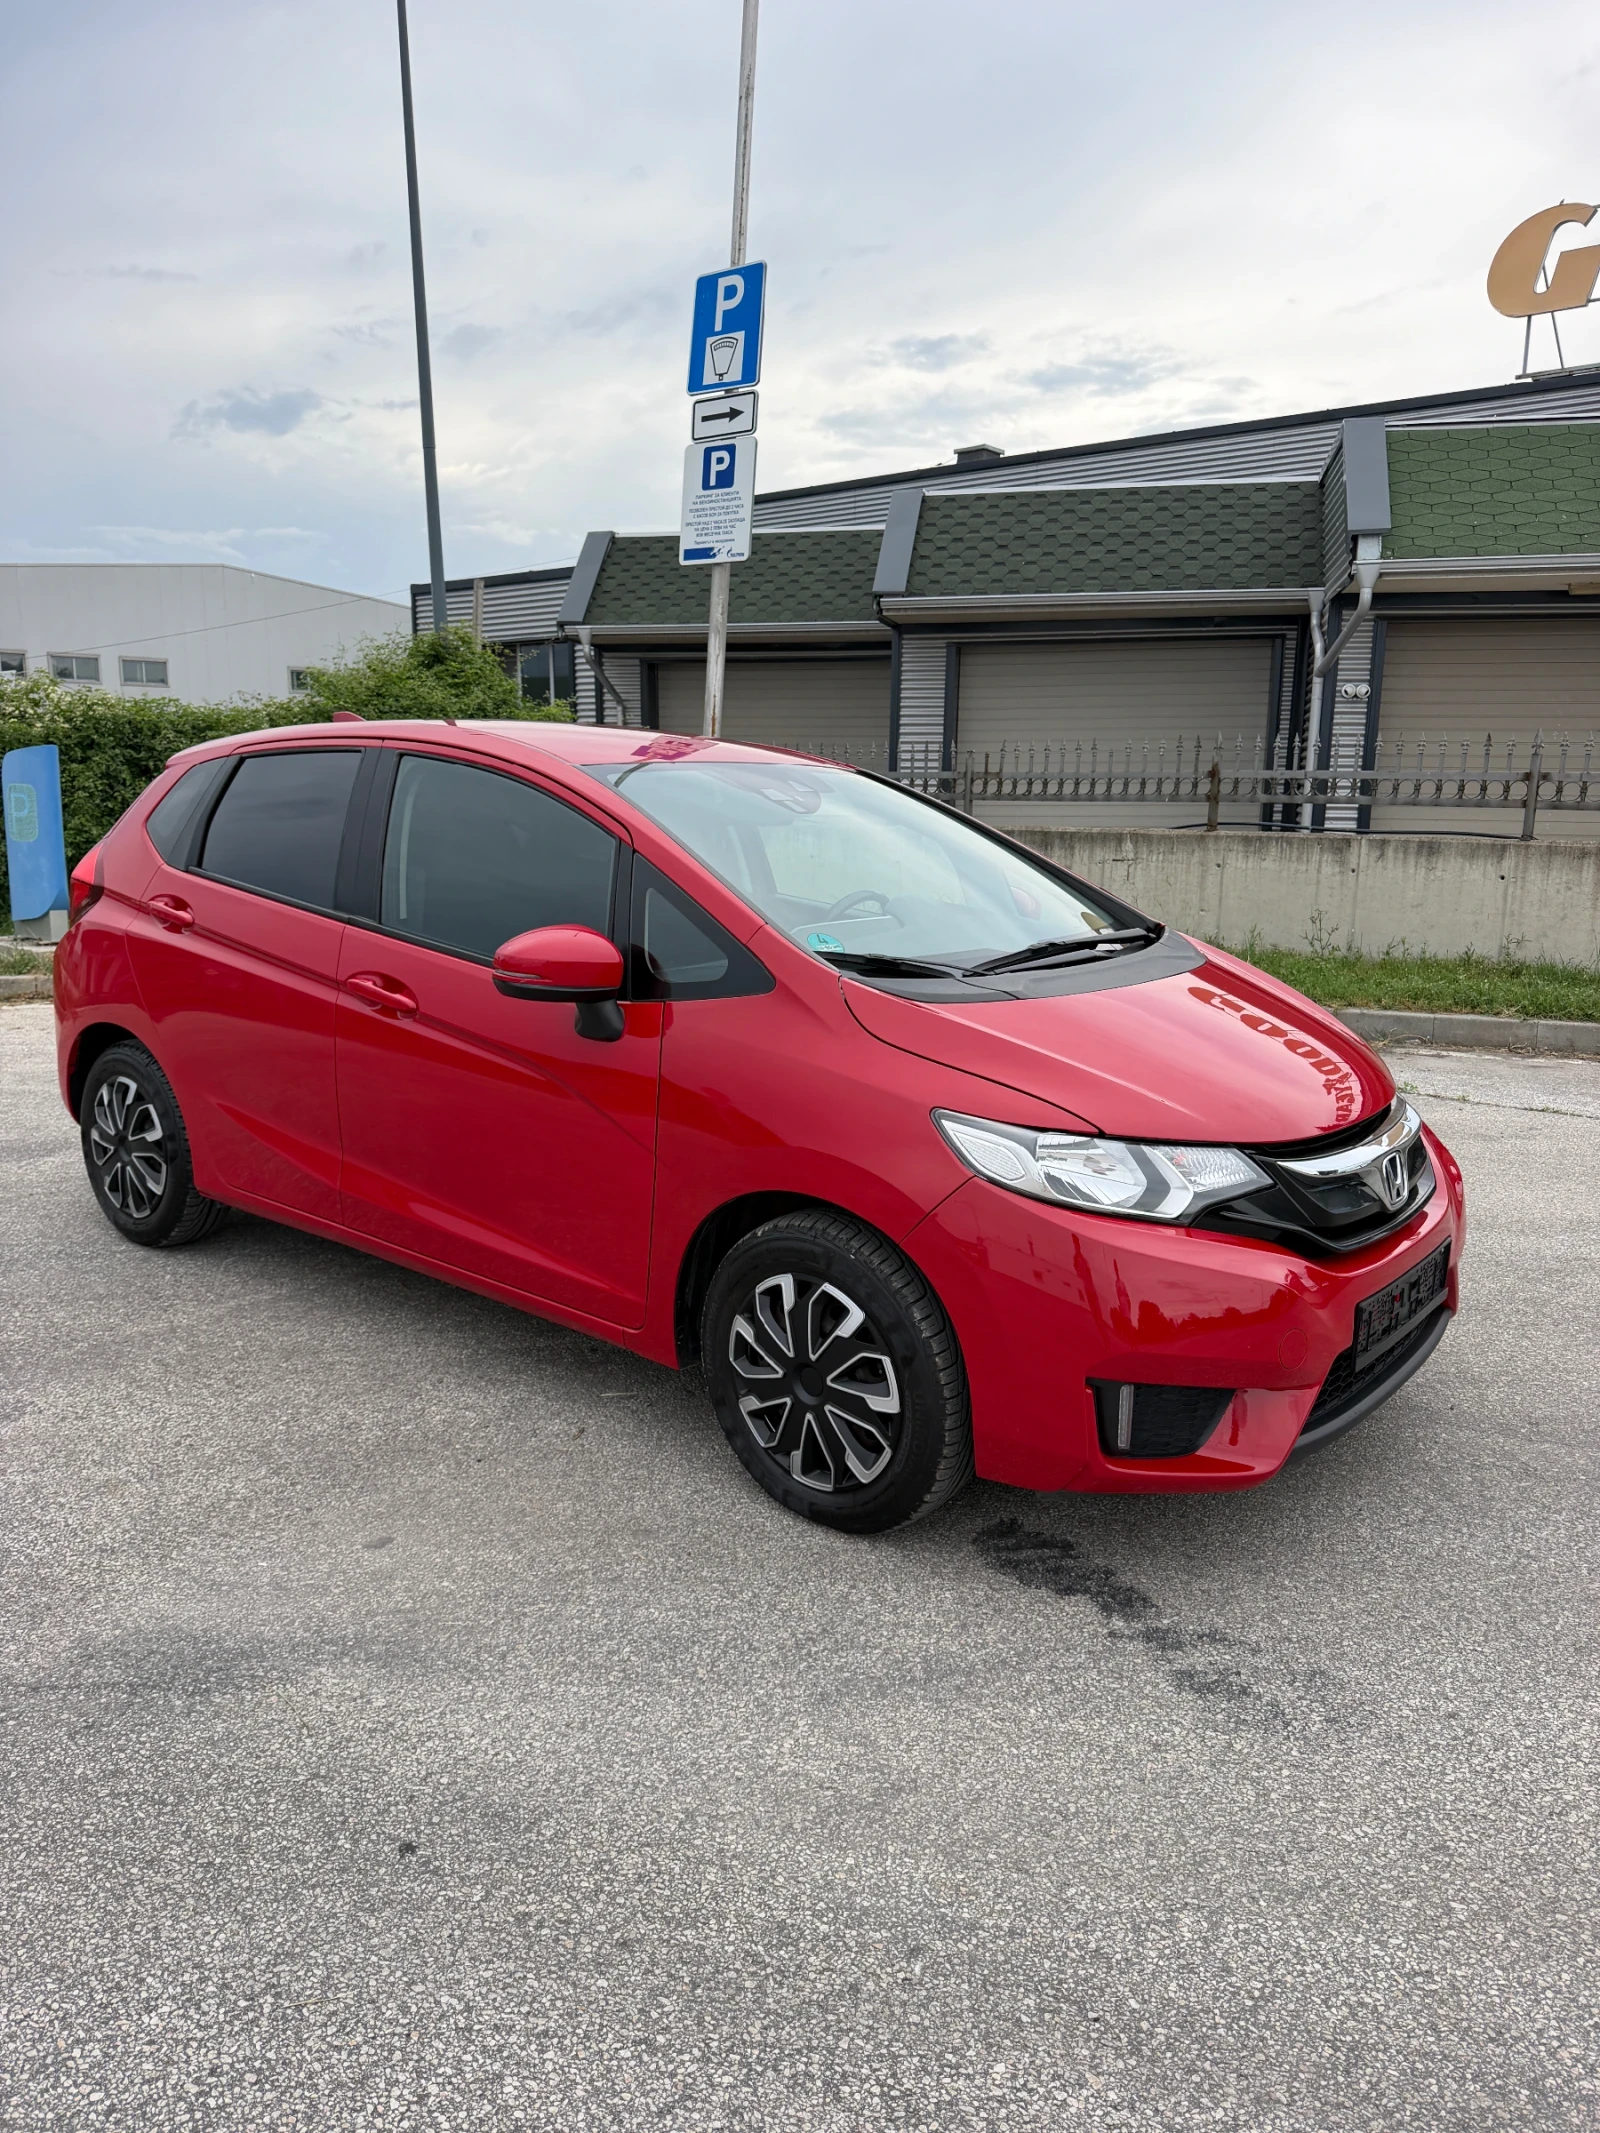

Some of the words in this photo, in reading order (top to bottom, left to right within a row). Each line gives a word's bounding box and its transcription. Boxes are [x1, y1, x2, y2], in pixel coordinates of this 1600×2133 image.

[714, 274, 745, 332] P
[709, 450, 731, 487] P
[816, 933, 829, 945] 4
